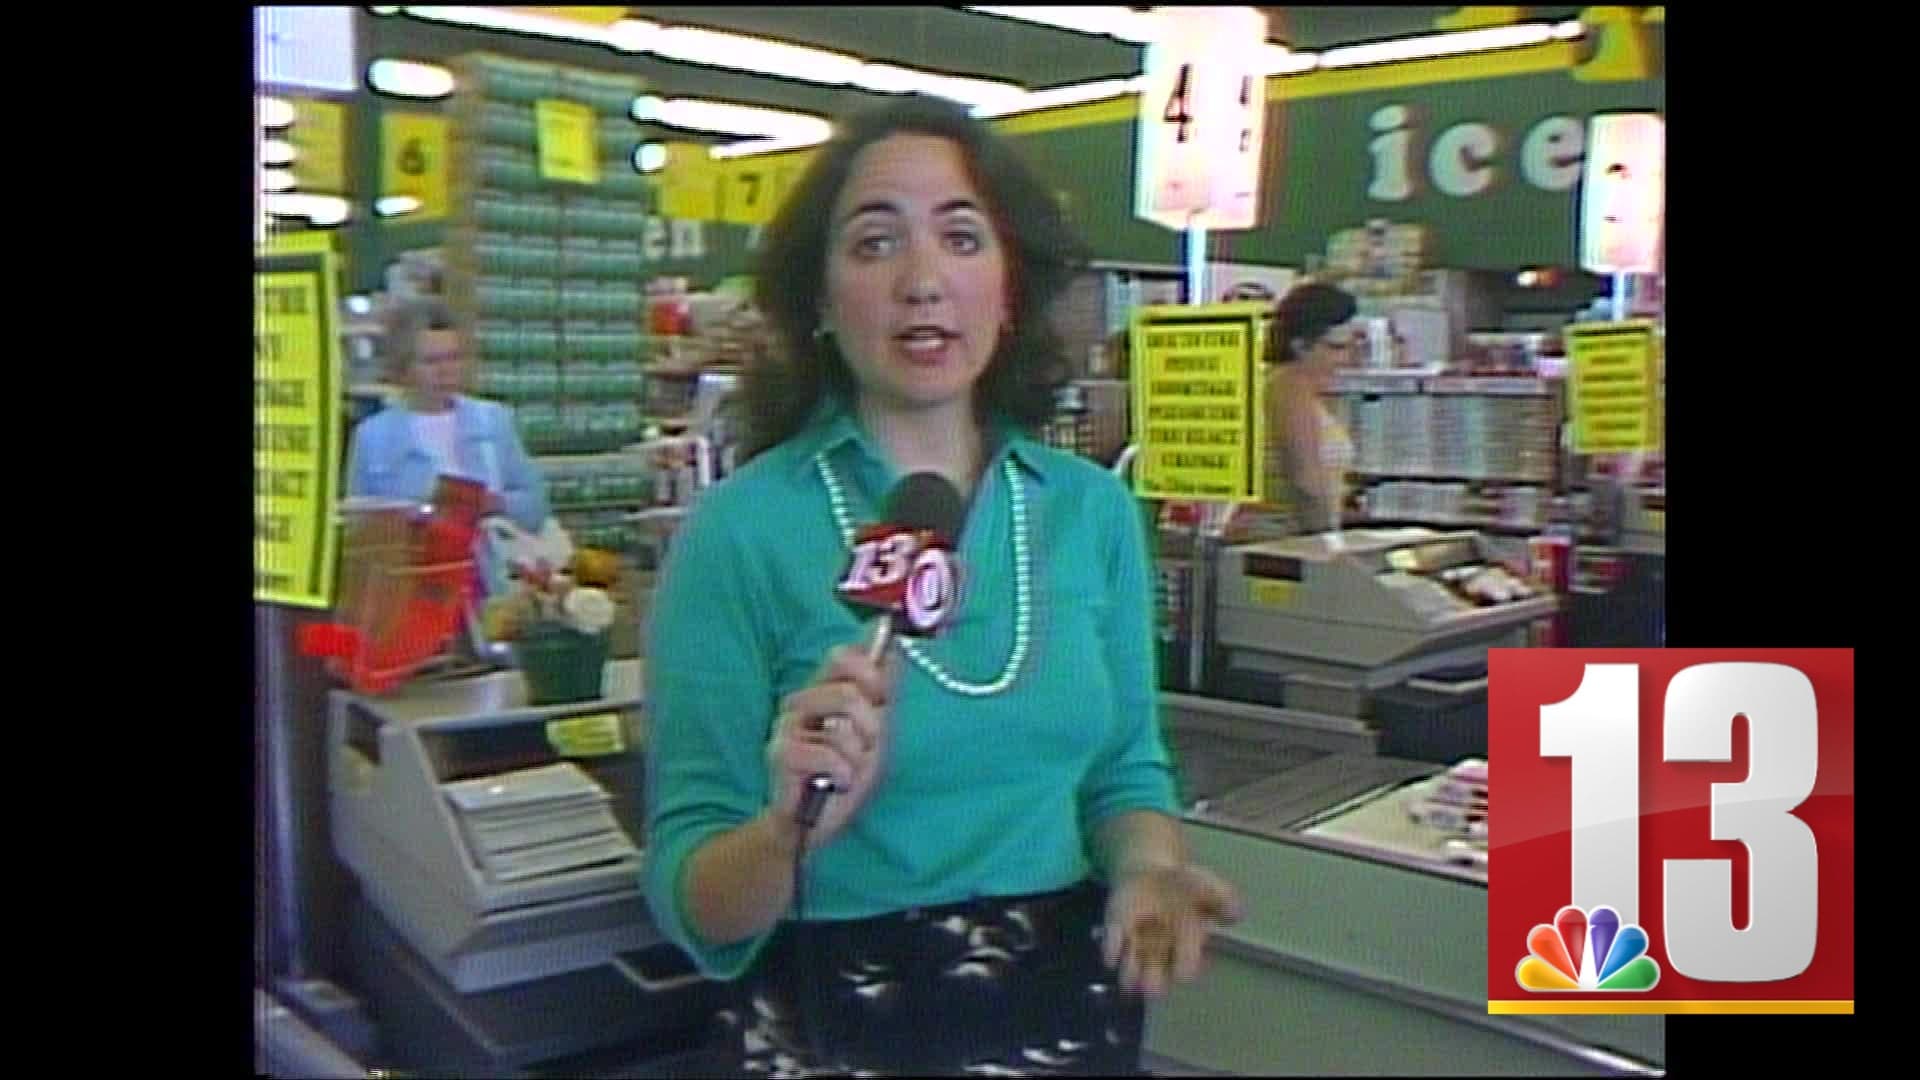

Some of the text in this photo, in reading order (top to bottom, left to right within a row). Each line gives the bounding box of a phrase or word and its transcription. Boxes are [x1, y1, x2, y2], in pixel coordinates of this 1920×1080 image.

[1163, 63, 1193, 143] 4
[396, 137, 426, 176] 6
[1367, 104, 1585, 201] ice
[738, 172, 762, 206] 7
[643, 217, 705, 258] en
[837, 533, 917, 592] 13
